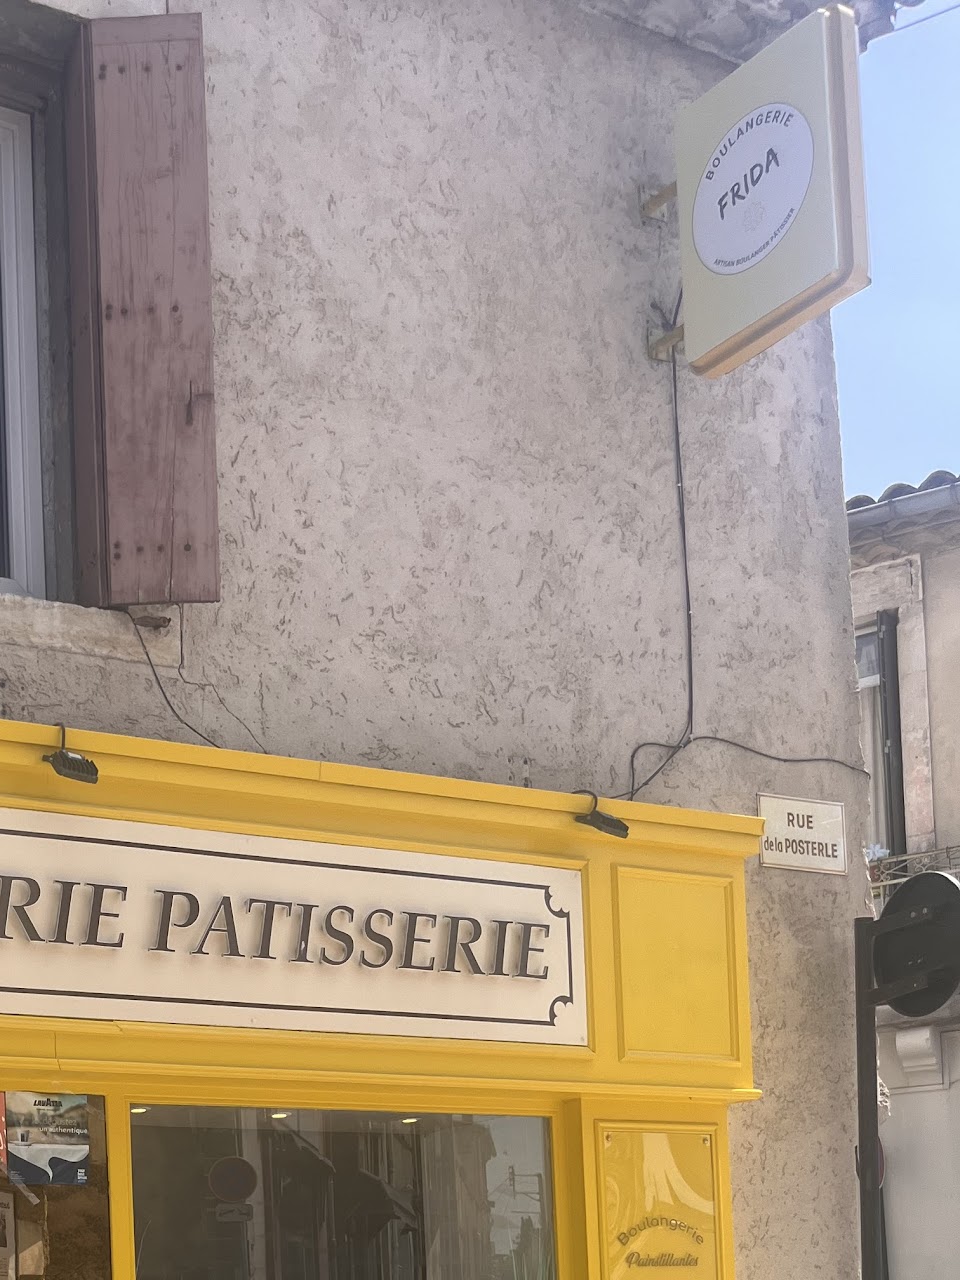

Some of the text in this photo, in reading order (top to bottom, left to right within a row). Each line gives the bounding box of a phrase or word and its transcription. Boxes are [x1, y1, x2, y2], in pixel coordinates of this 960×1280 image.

[705, 110, 794, 181] BOULANGERIE
[717, 147, 780, 221] FRIDA
[714, 258, 735, 267] ARTISAN
[736, 241, 770, 266] BOULANGER
[787, 812, 813, 829] RUE
[784, 838, 838, 858] POSTERLE
[148, 888, 551, 981] PATISSERIE
[33, 1098, 62, 1107] LAVAZZA
[49, 1126, 88, 1135] authentique
[617, 1216, 704, 1246] Boulangerie
